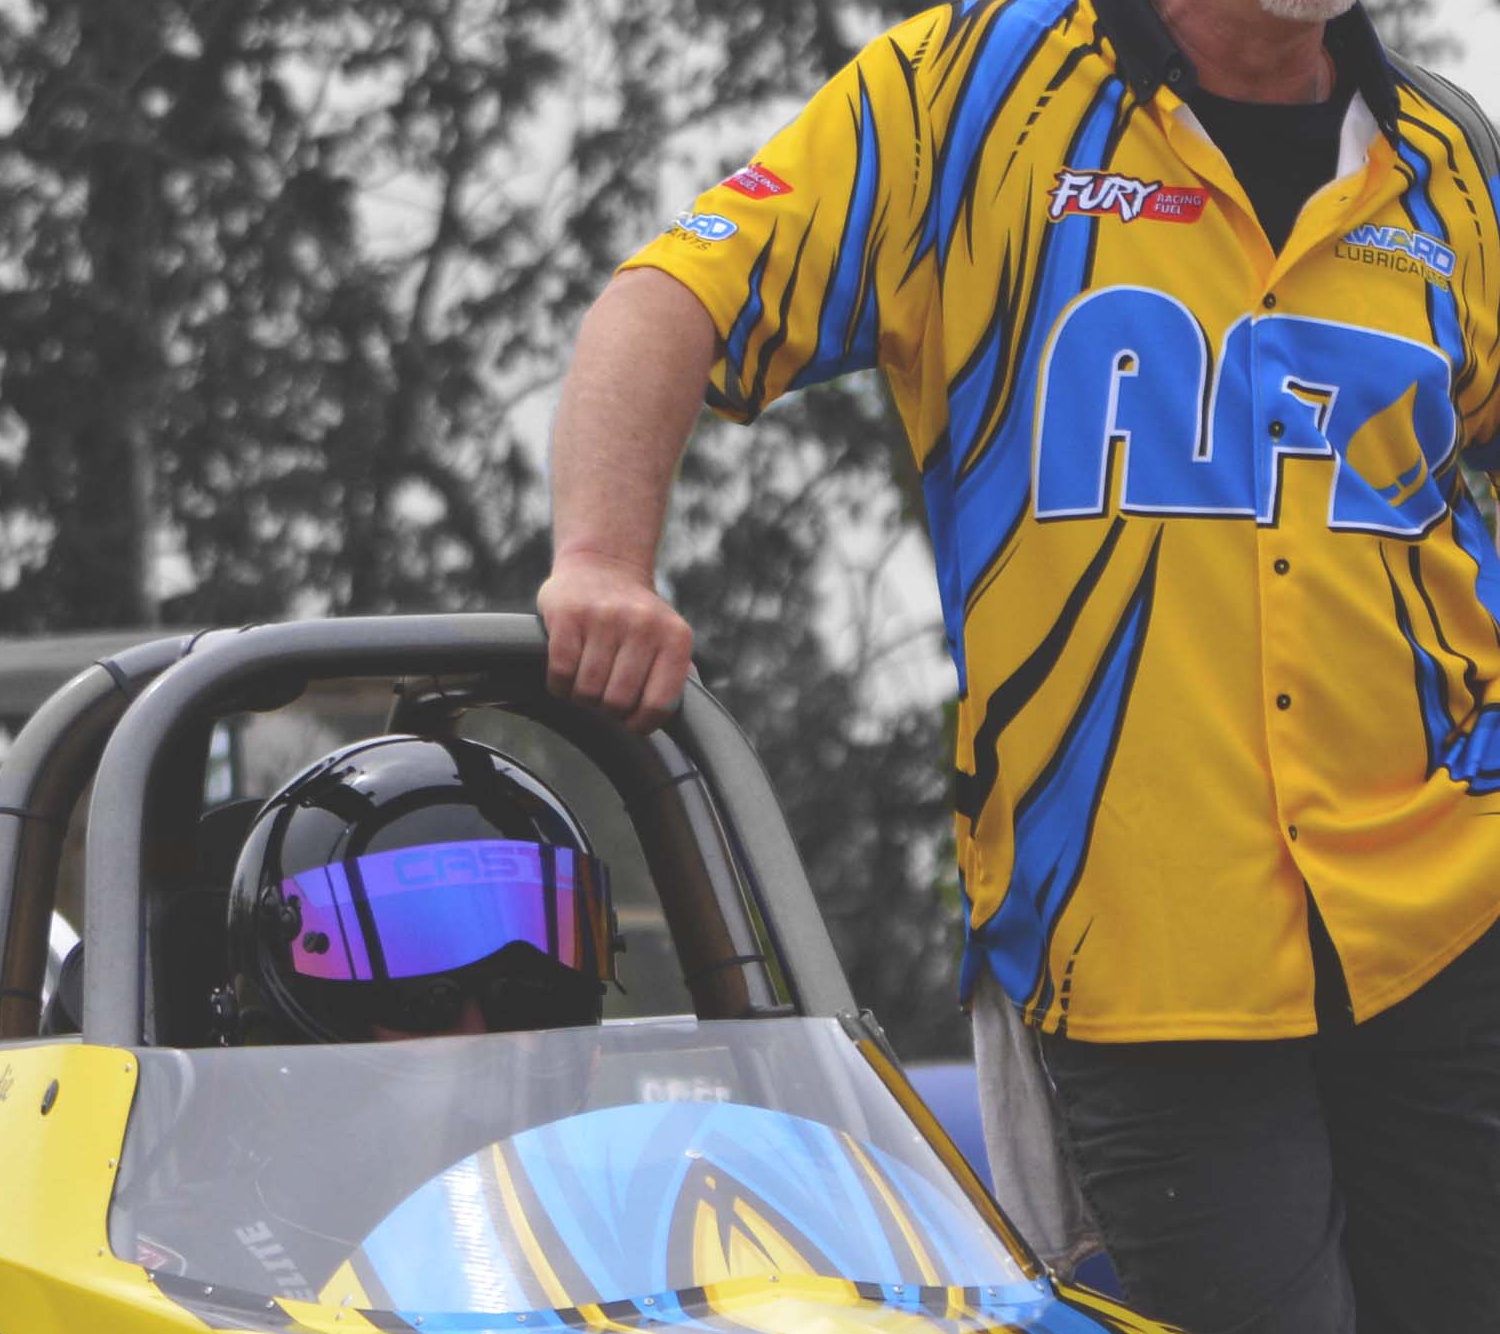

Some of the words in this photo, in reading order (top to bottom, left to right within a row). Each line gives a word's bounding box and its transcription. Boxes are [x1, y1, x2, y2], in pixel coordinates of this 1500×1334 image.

[1050, 172, 1161, 223] FURY
[1156, 193, 1202, 206] RACING
[1153, 202, 1183, 216] FUEL
